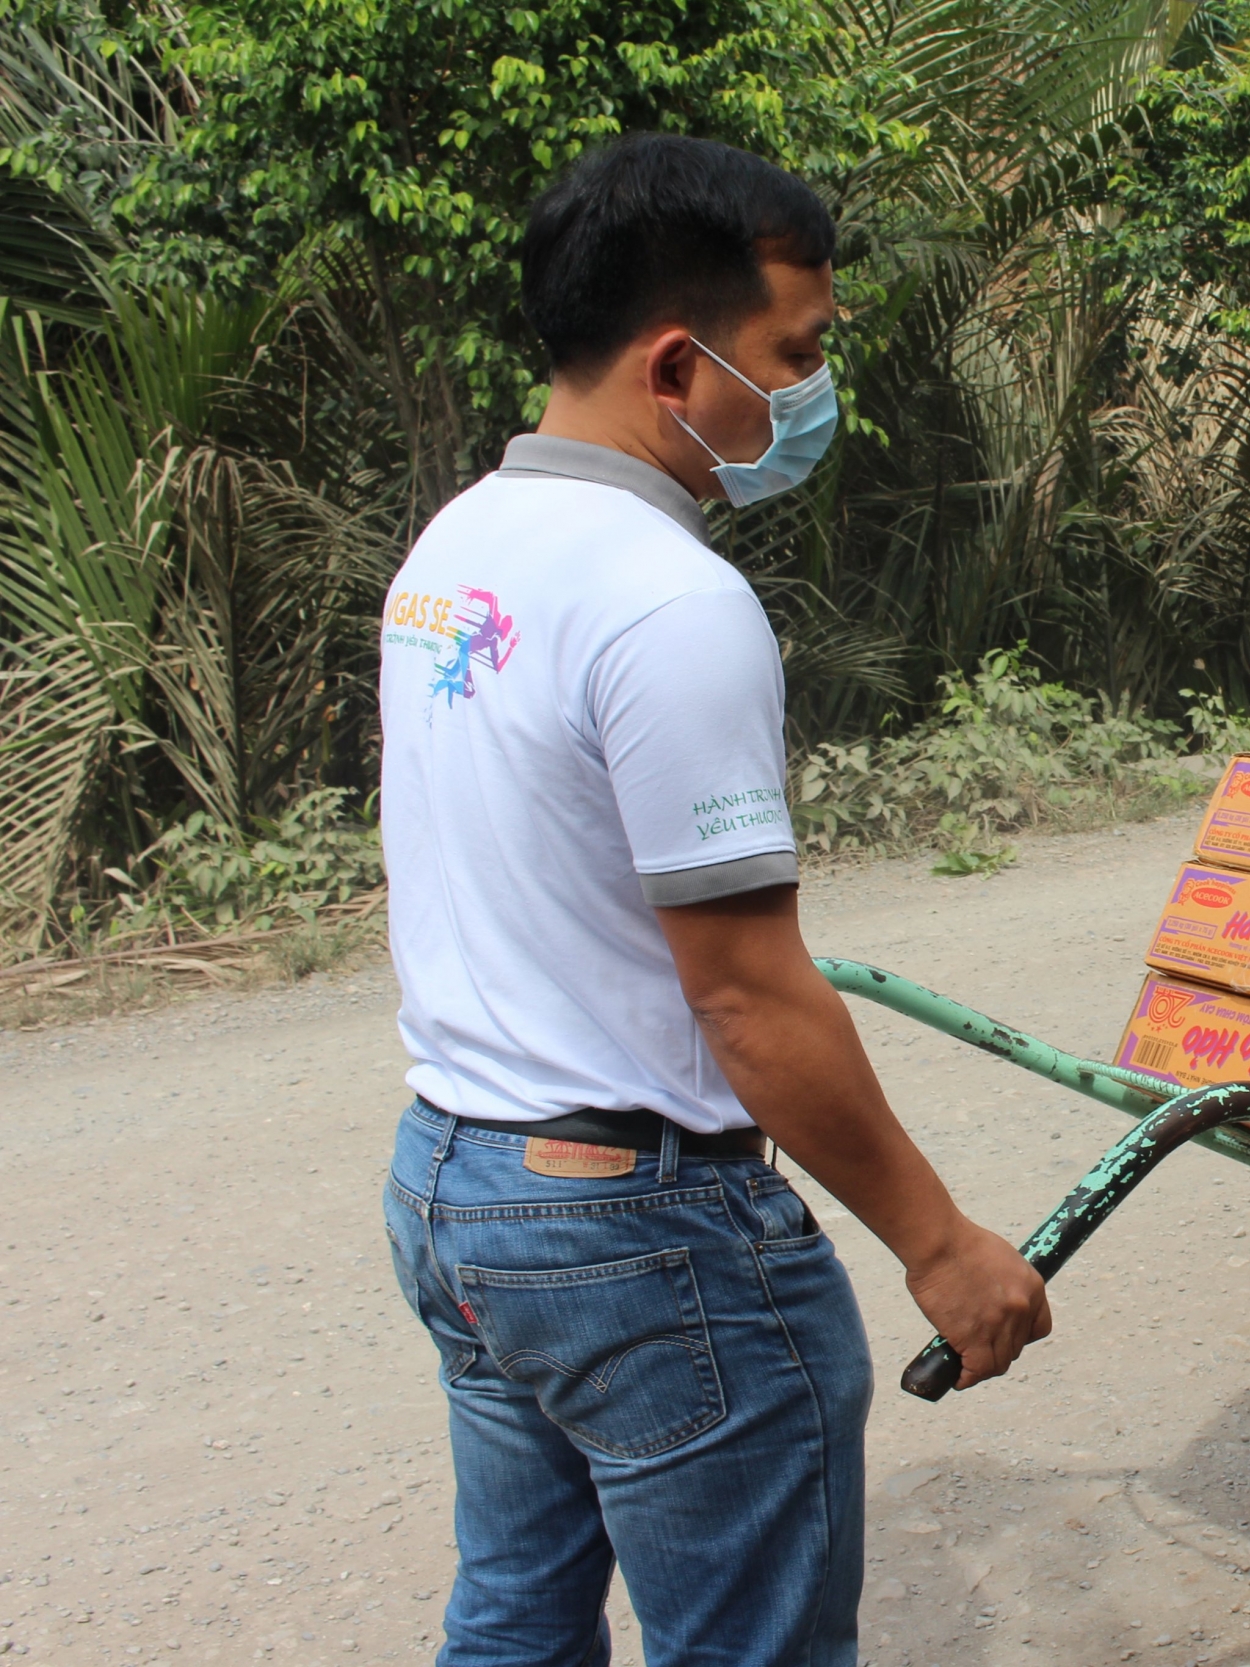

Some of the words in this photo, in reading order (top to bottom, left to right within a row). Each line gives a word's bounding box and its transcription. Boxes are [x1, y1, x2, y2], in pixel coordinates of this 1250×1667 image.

[429, 597, 453, 635] SE
[692, 794, 747, 816] HÀNH
[746, 786, 781, 803] TRÌNH
[696, 817, 737, 841] YÊU
[1149, 989, 1195, 1028] 20
[1181, 1025, 1240, 1070] Hảo
[545, 1160, 562, 1168] 511
